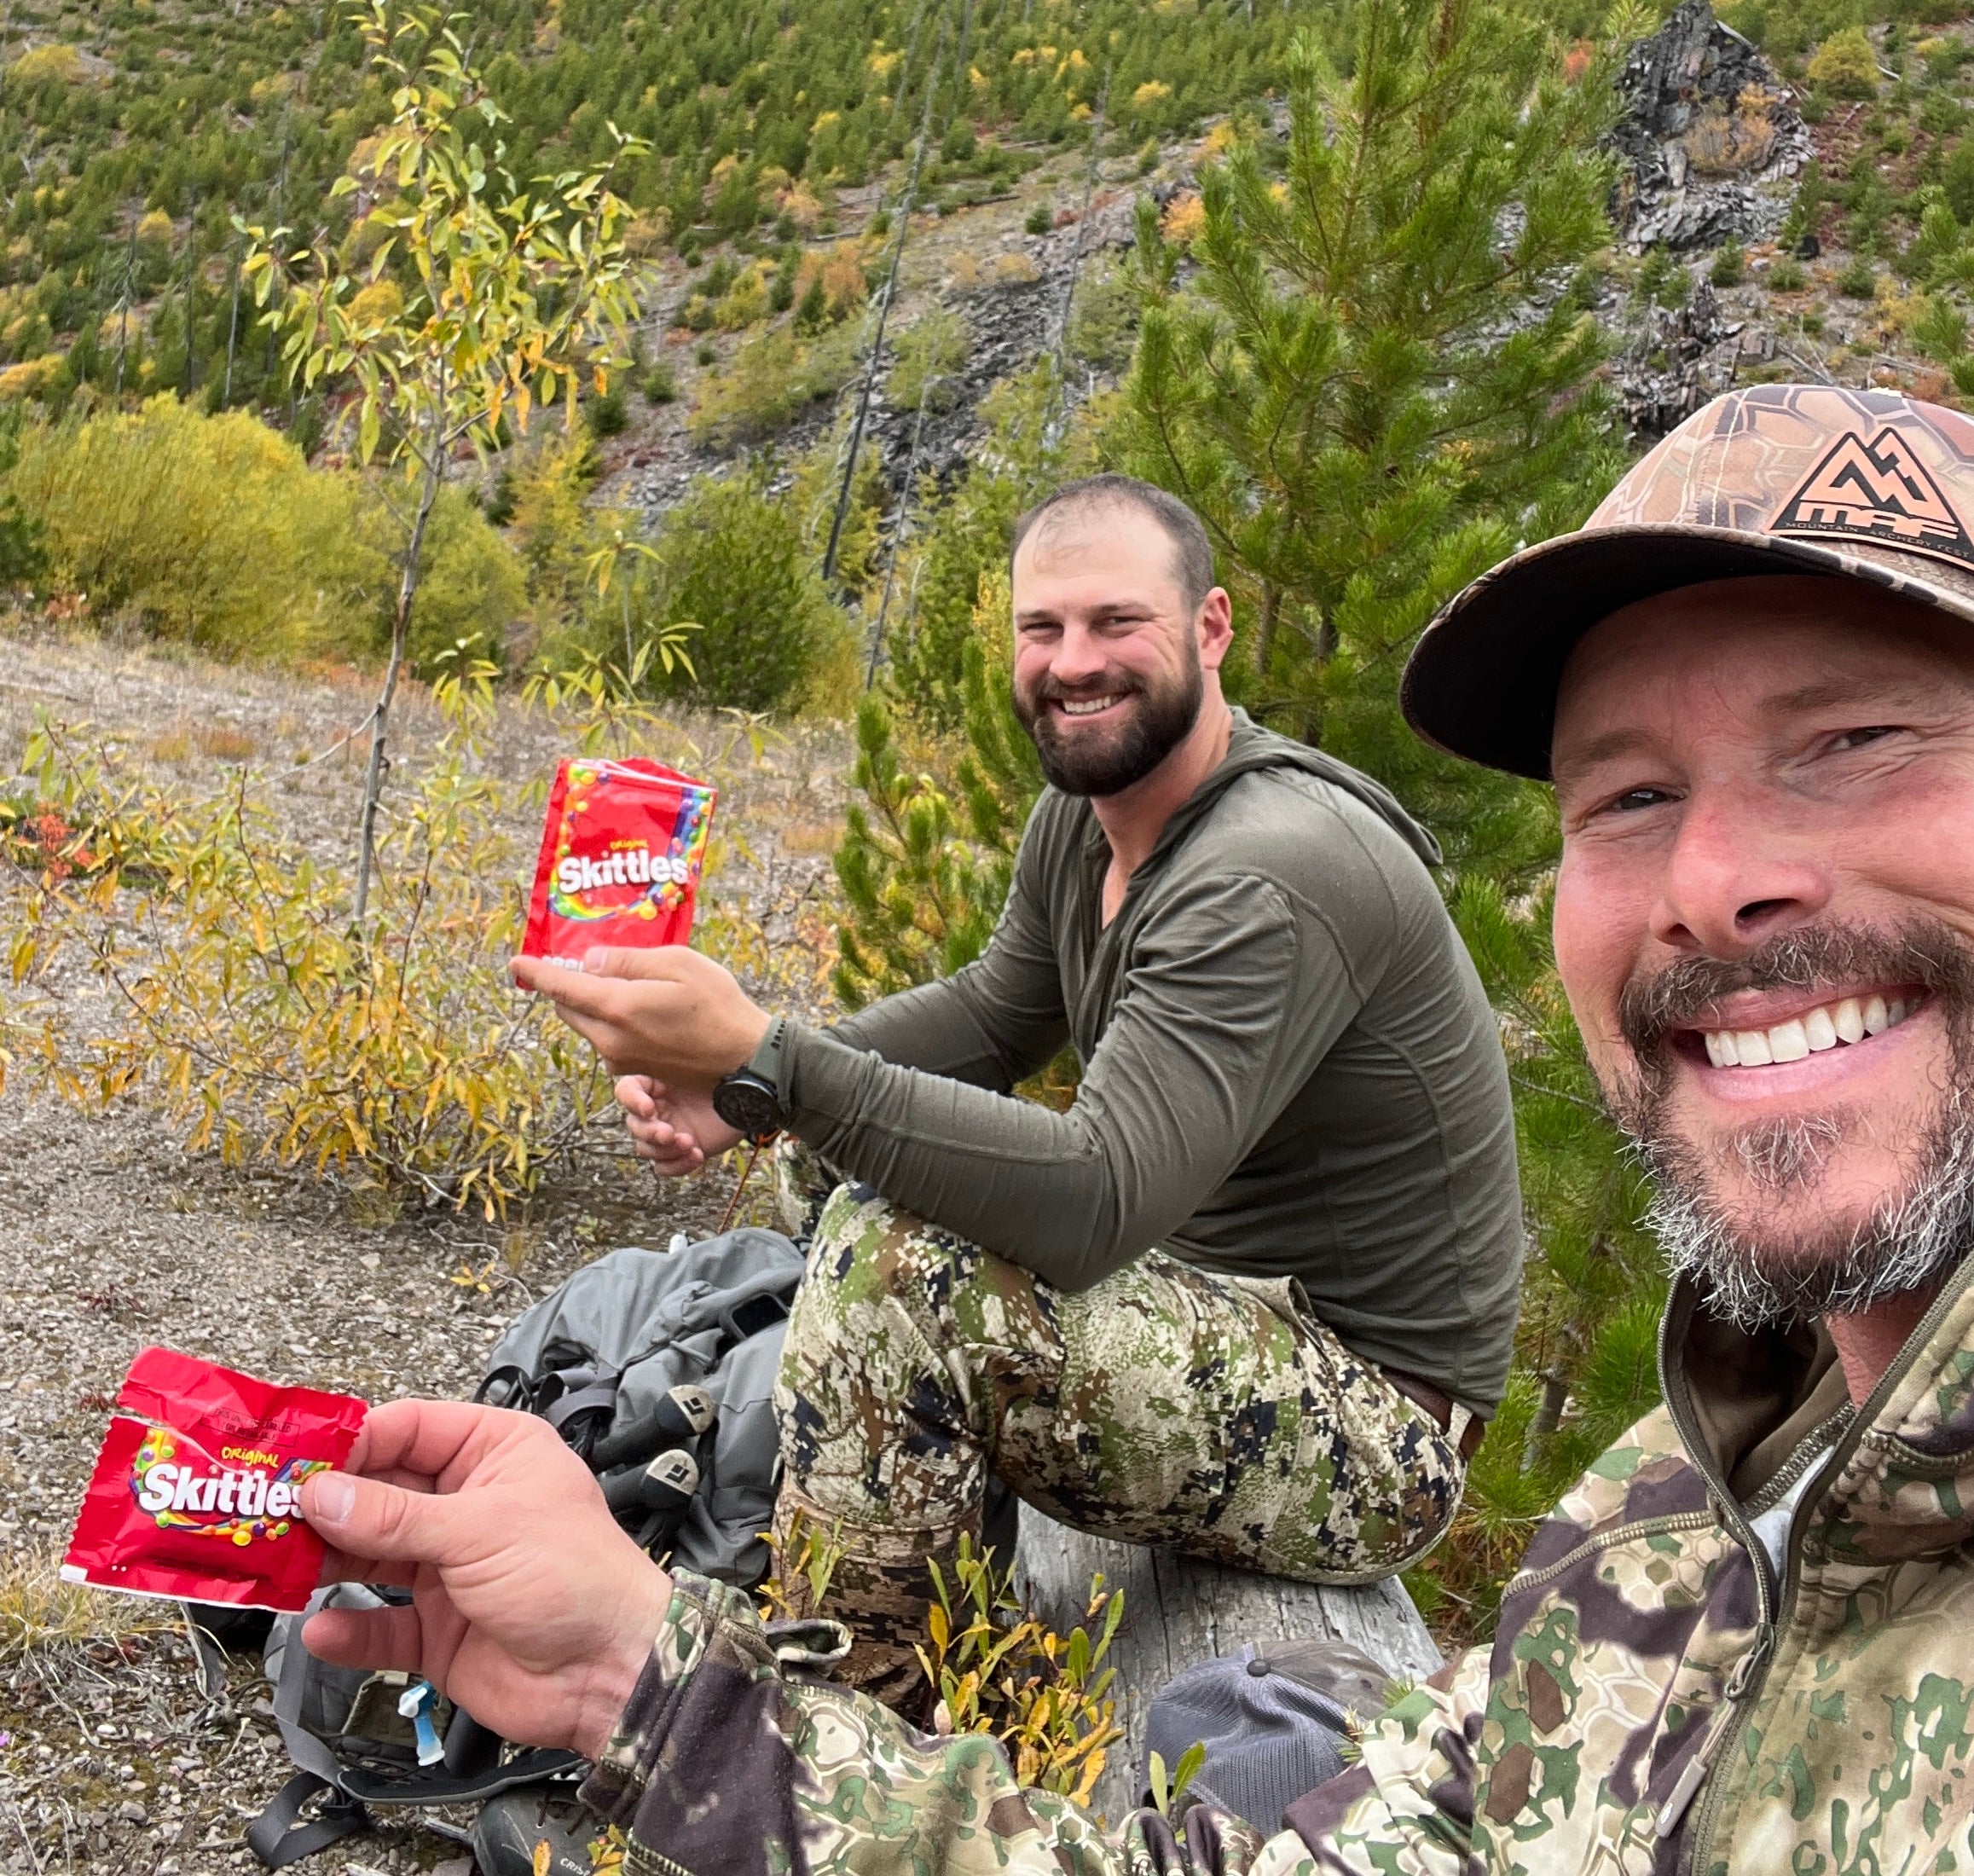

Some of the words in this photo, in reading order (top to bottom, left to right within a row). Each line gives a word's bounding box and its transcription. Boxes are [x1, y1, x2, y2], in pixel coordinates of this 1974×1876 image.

[1785, 522, 1859, 533] MOUNTAIN
[1869, 530, 1931, 547] ARCHERY
[558, 848, 689, 894] Skittles
